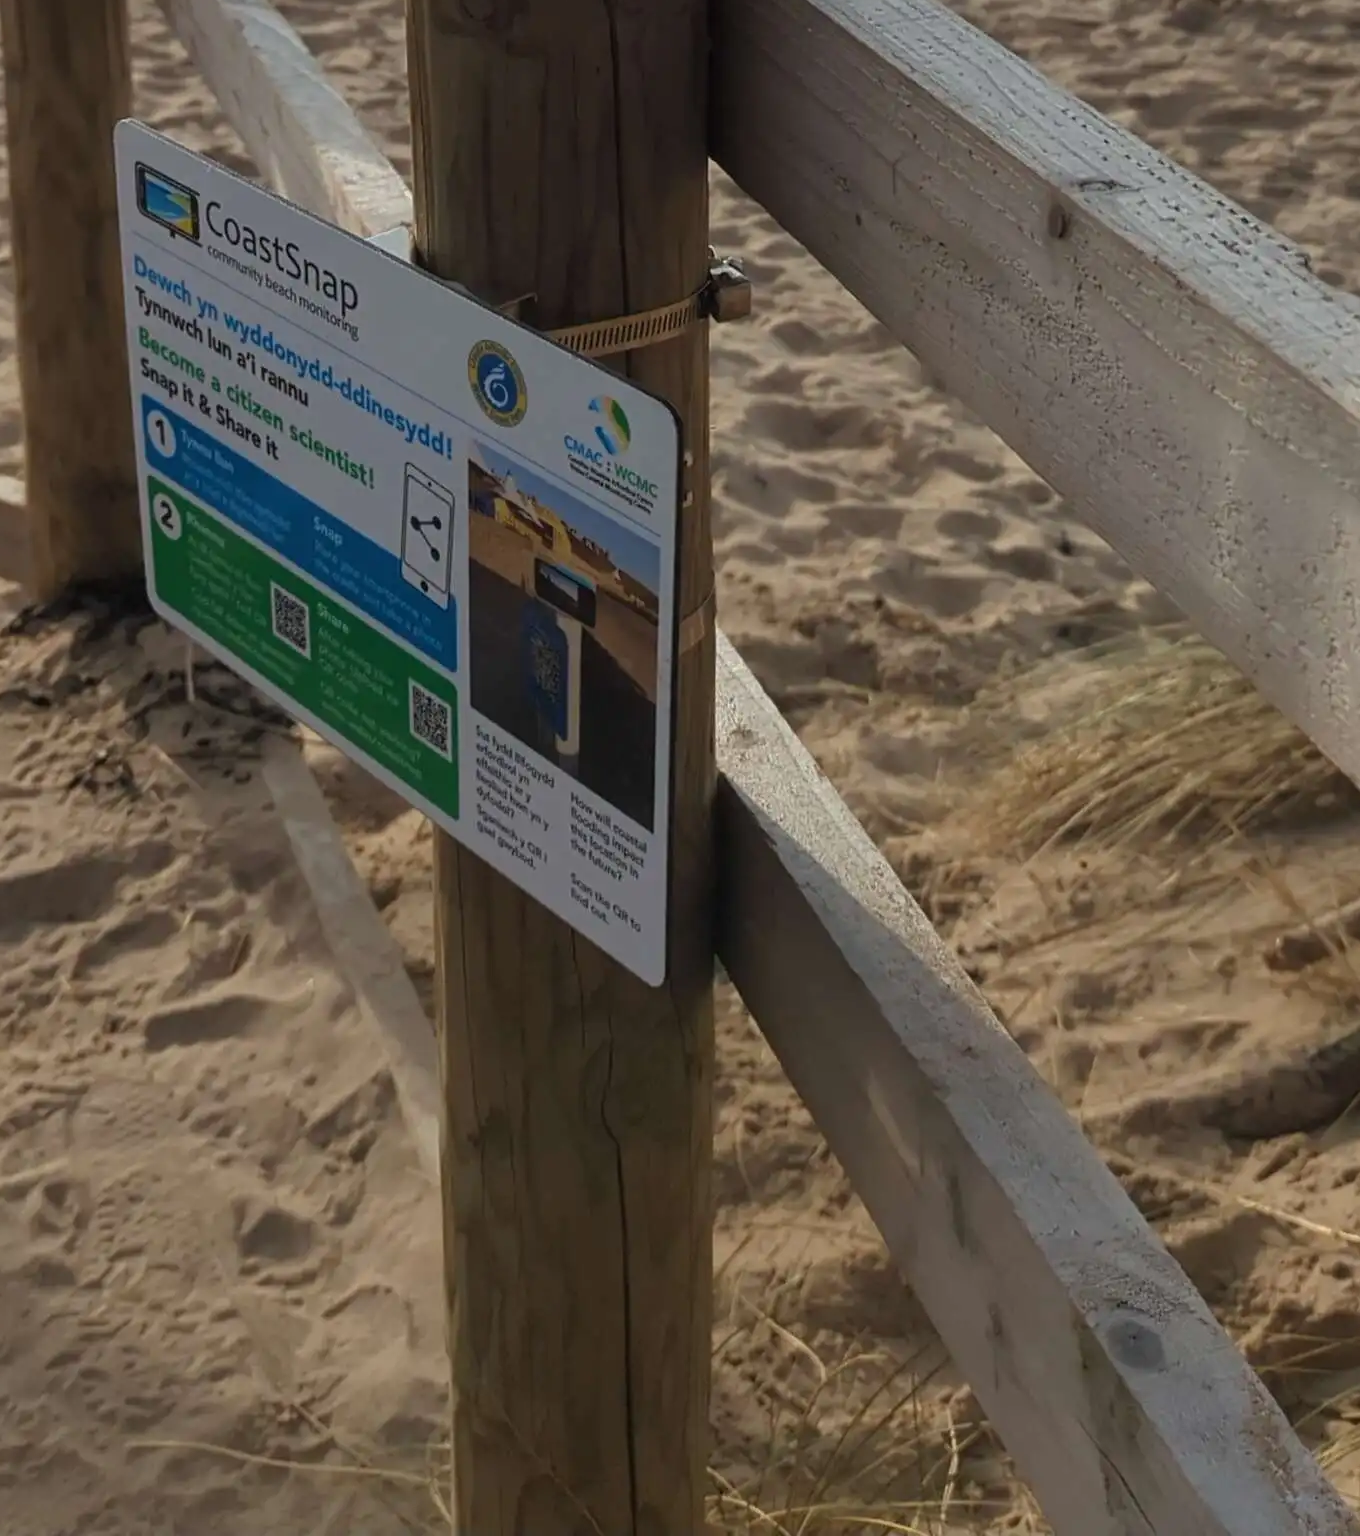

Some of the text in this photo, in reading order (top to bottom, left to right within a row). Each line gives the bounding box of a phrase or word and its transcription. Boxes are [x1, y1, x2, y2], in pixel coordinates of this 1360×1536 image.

[205, 201, 360, 315] CoastSnap
[207, 244, 360, 342] community beach monitoring
[133, 254, 192, 307] Dewch
[196, 295, 220, 322] yn
[223, 308, 453, 461] wyddonydd-ddinesydd!
[134, 285, 204, 343] Tynnwch
[208, 326, 233, 361] lun
[259, 366, 310, 408] rannu
[137, 326, 375, 490] Become a citizen scientist!
[140, 355, 280, 461] Snap it & Share it
[154, 418, 166, 447] 1
[159, 500, 174, 531] 2
[563, 434, 605, 467] CMAC
[613, 460, 659, 500] WCMC
[313, 515, 343, 547] Snap
[317, 602, 351, 635] Share
